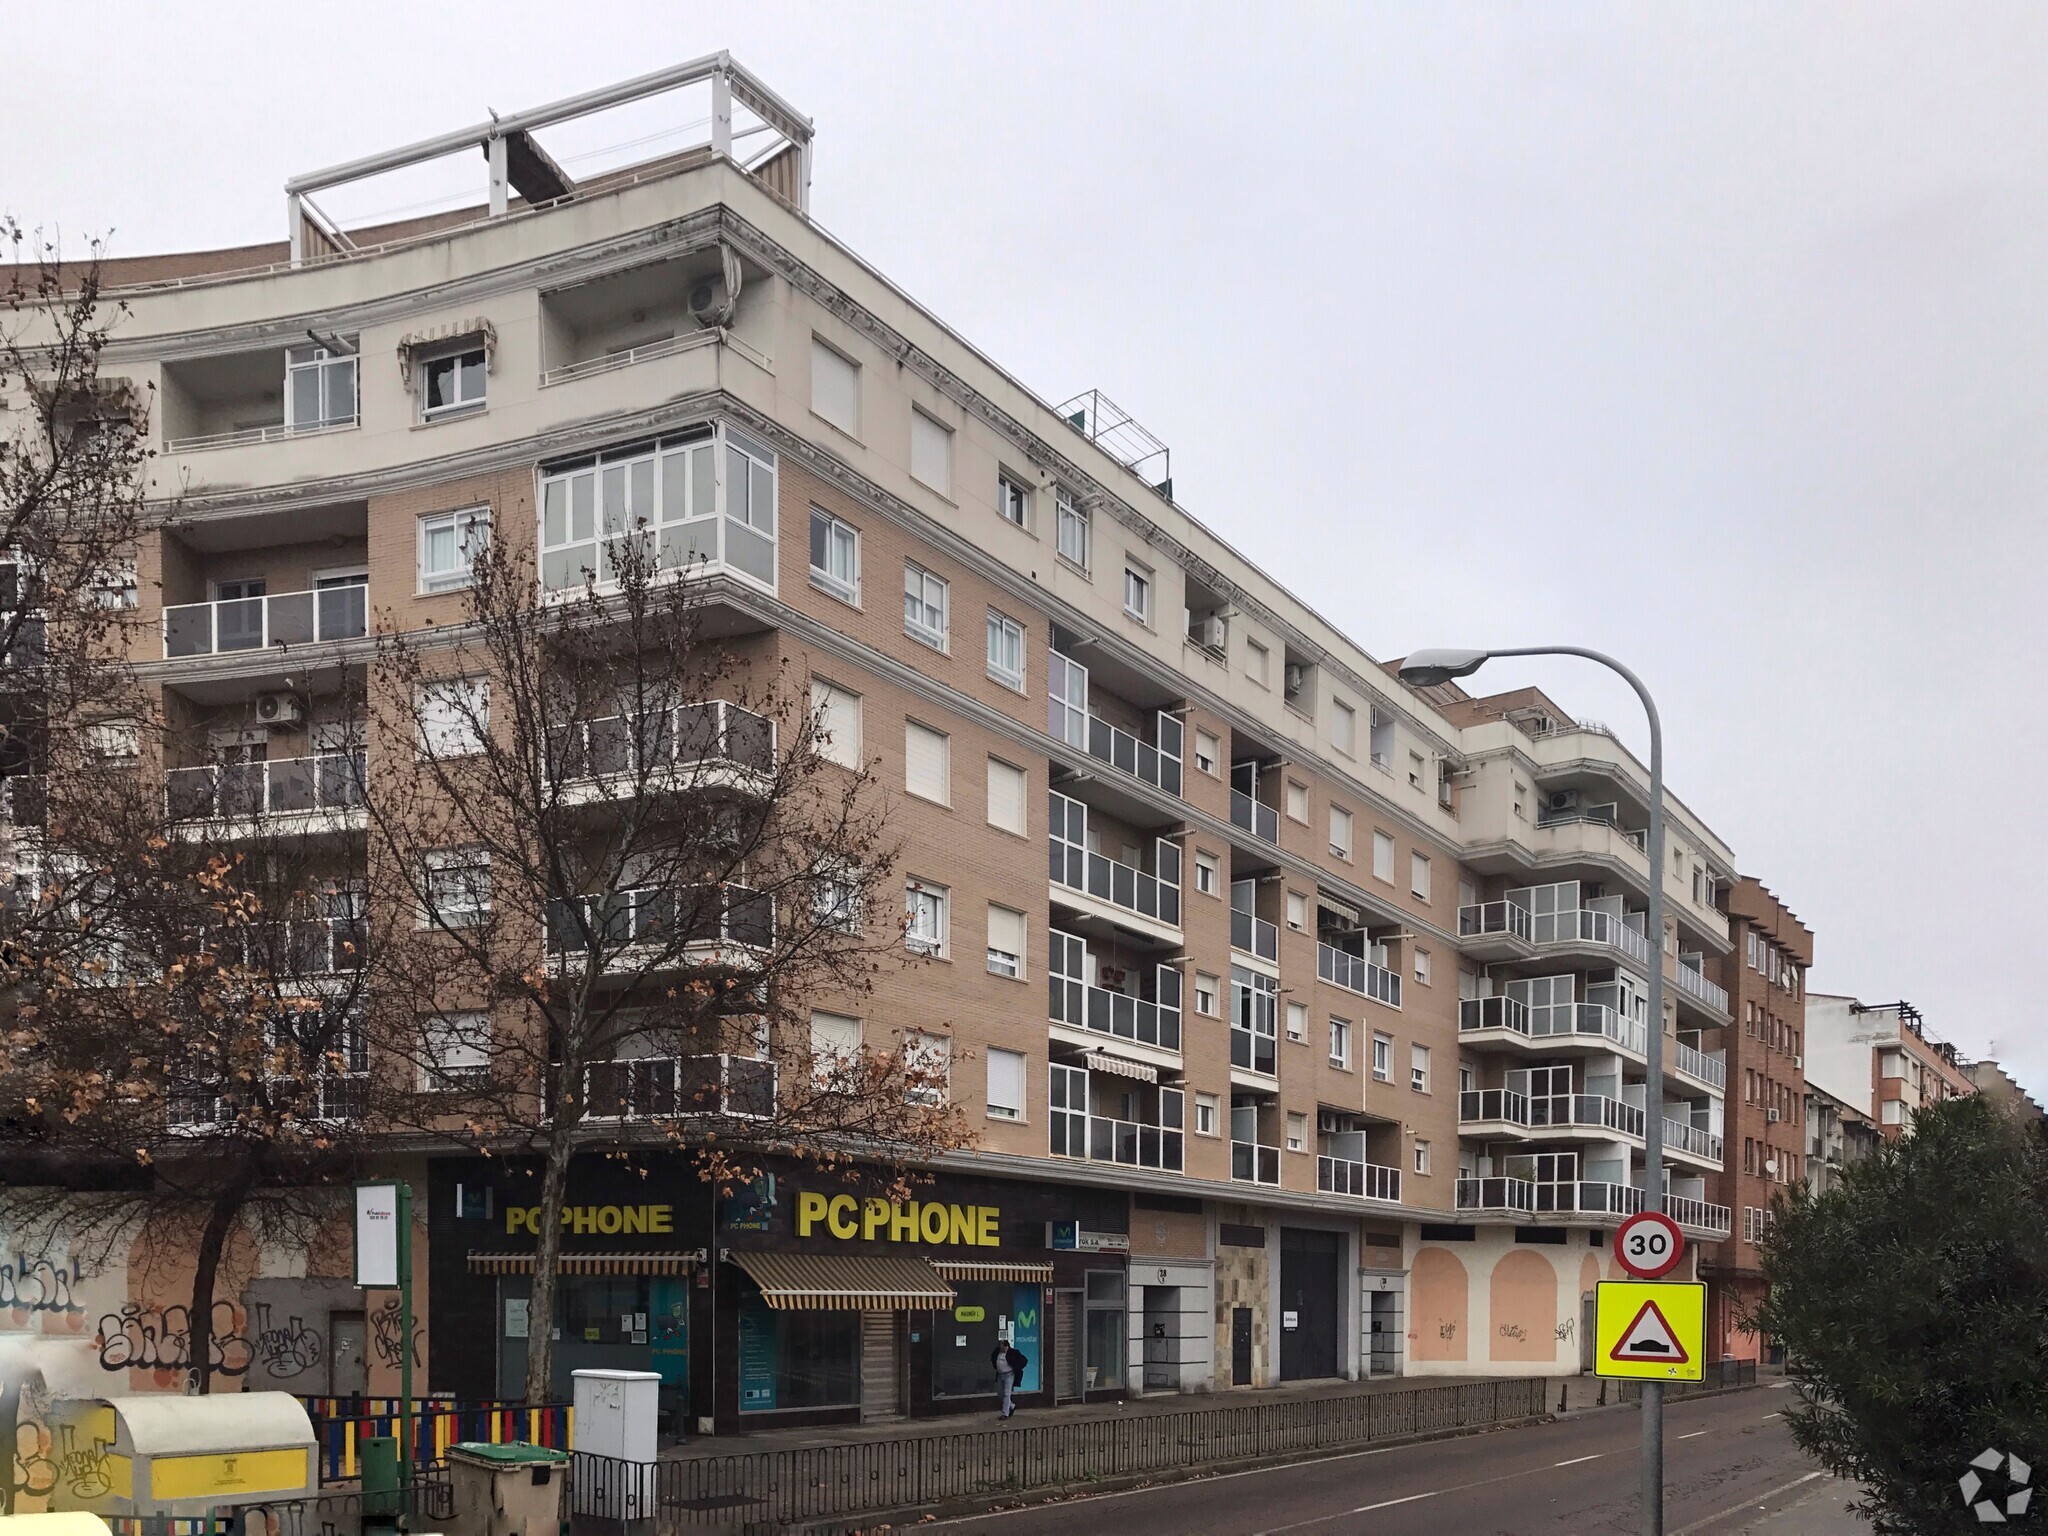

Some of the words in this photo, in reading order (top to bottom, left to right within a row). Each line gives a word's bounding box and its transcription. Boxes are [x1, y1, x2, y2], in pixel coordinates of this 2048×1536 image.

[795, 1192, 858, 1240] PC
[861, 1197, 1000, 1247] PHONE
[1630, 1234, 1667, 1256] 30
